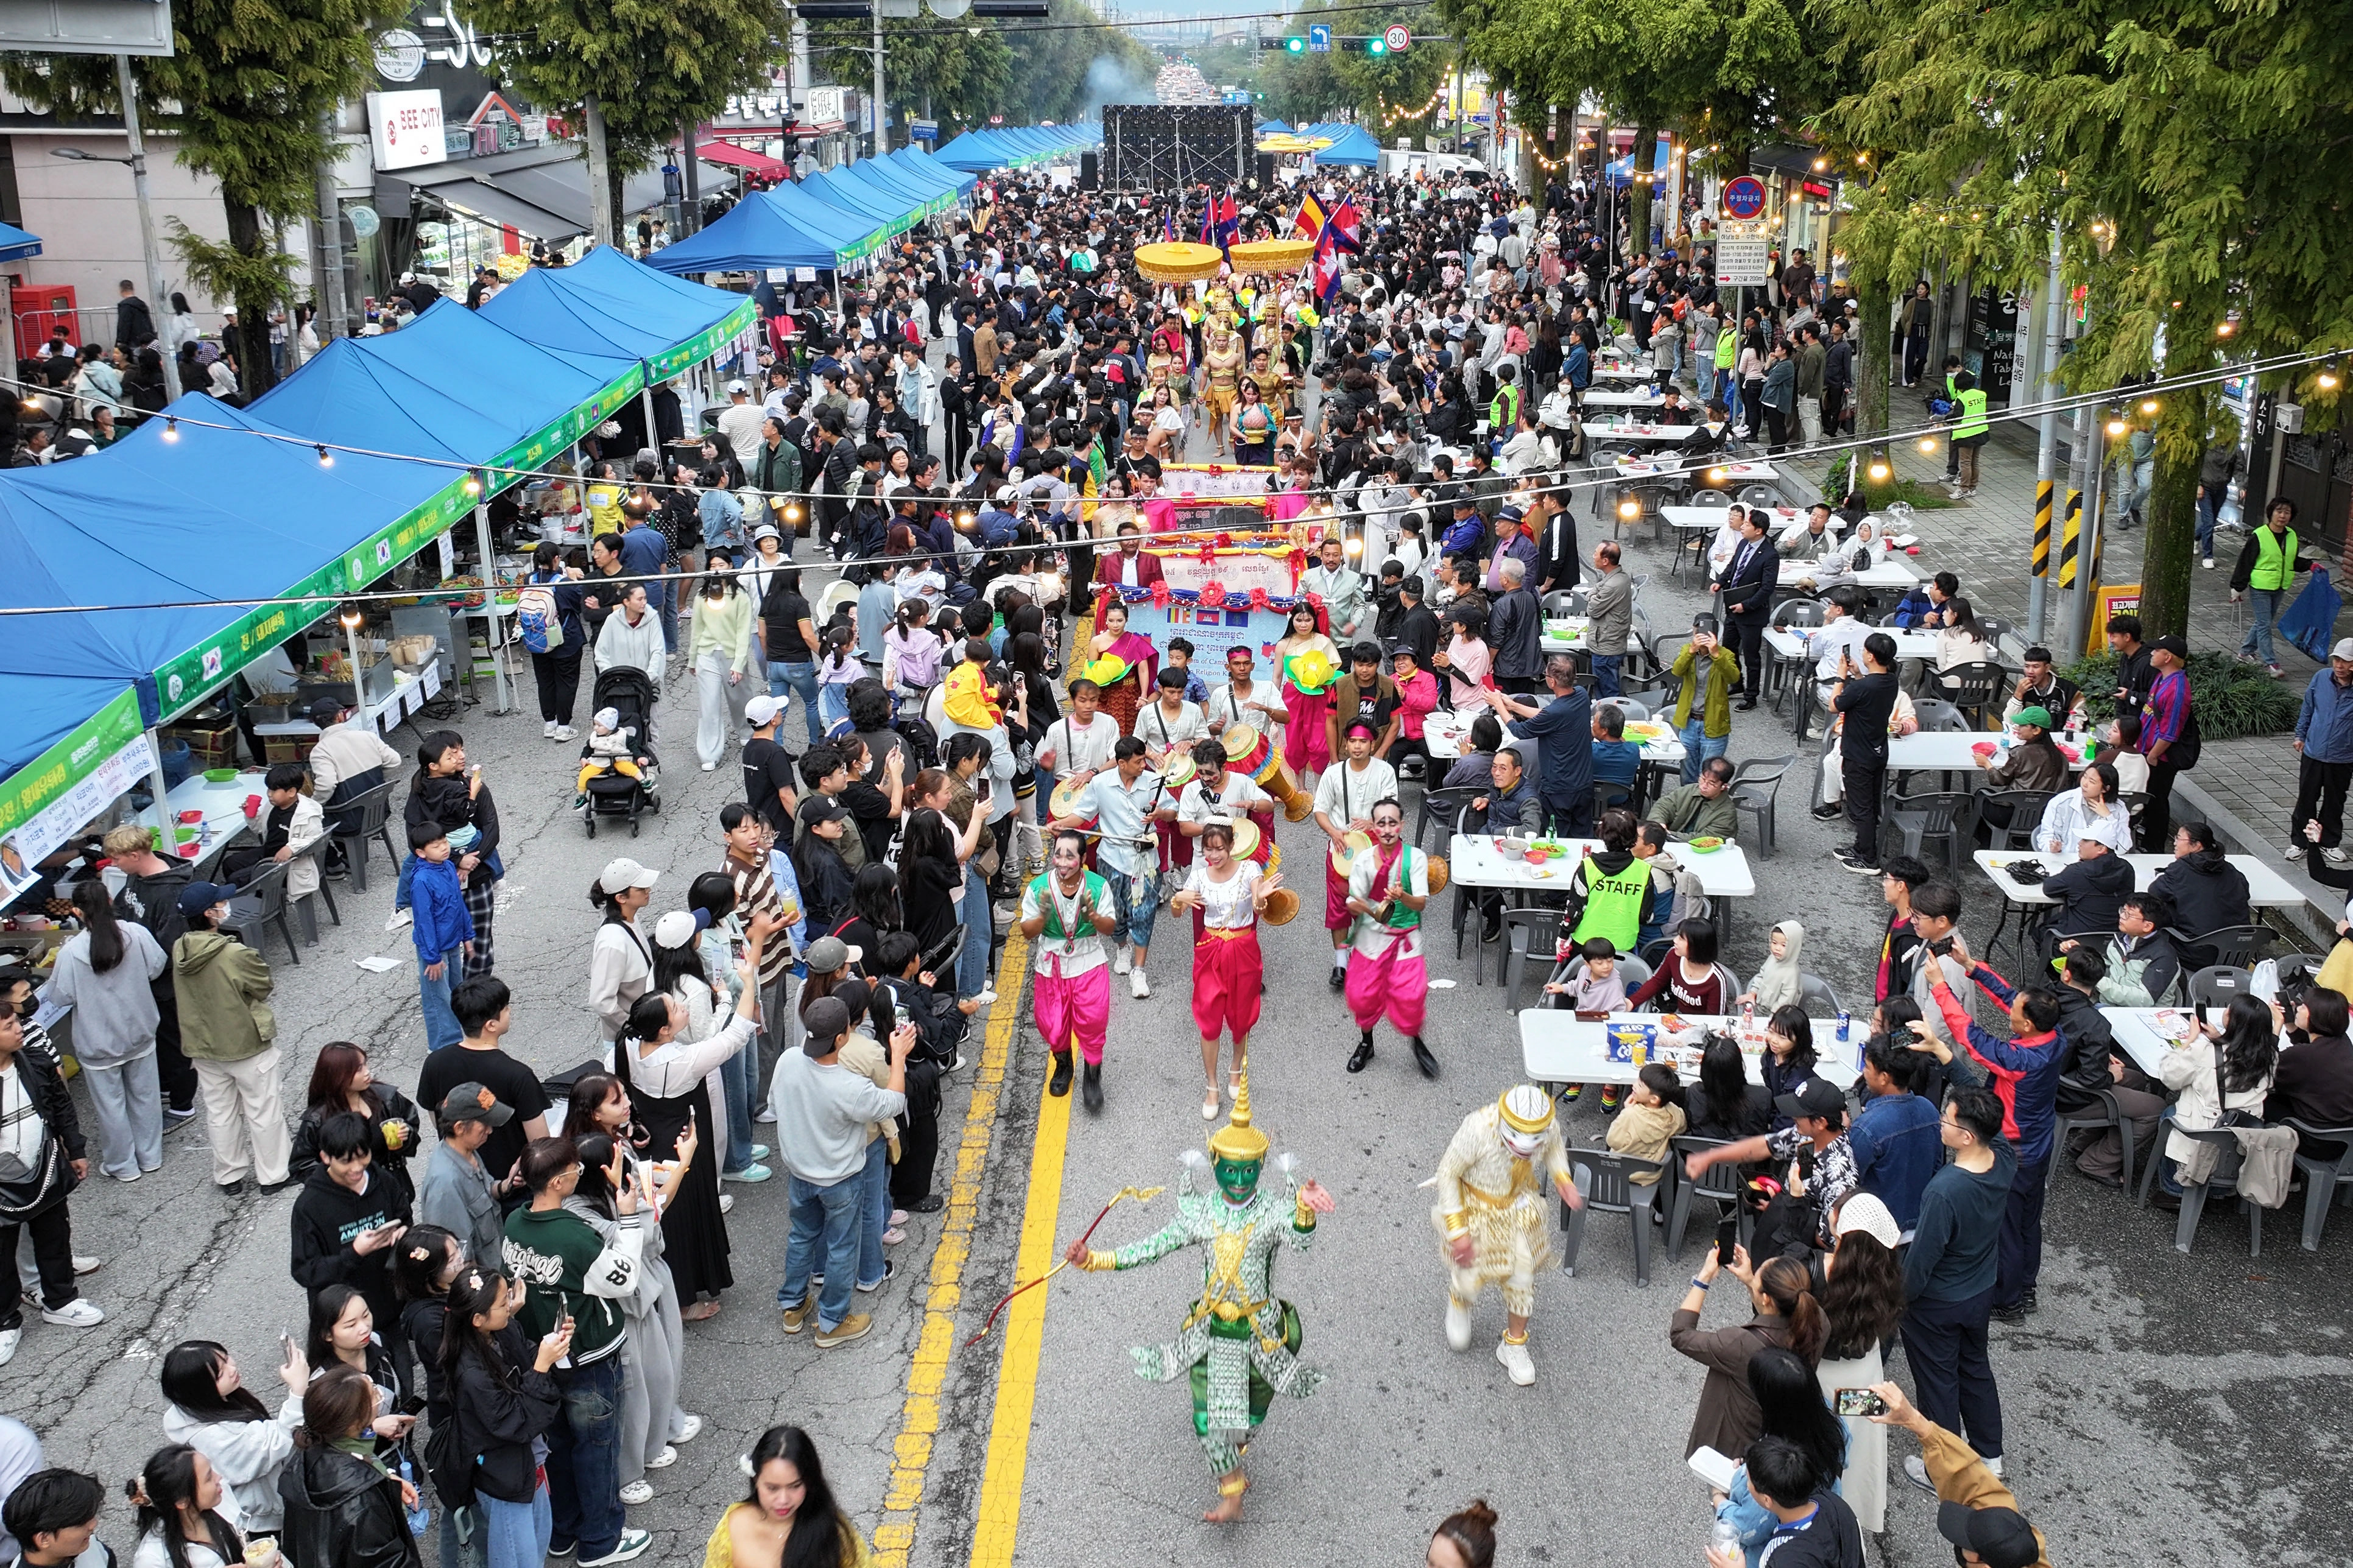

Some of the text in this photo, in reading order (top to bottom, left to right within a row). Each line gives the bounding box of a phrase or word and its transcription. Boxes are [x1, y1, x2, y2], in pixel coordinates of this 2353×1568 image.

[1390, 33, 1405, 44] 30
[400, 107, 440, 130] BEE CITY
[2017, 325, 2028, 339] 사주
[255, 610, 285, 641] 돼지편육
[1595, 879, 1642, 896] STAFF
[1671, 977, 1702, 1006] adblood
[501, 1236, 564, 1285] Original
